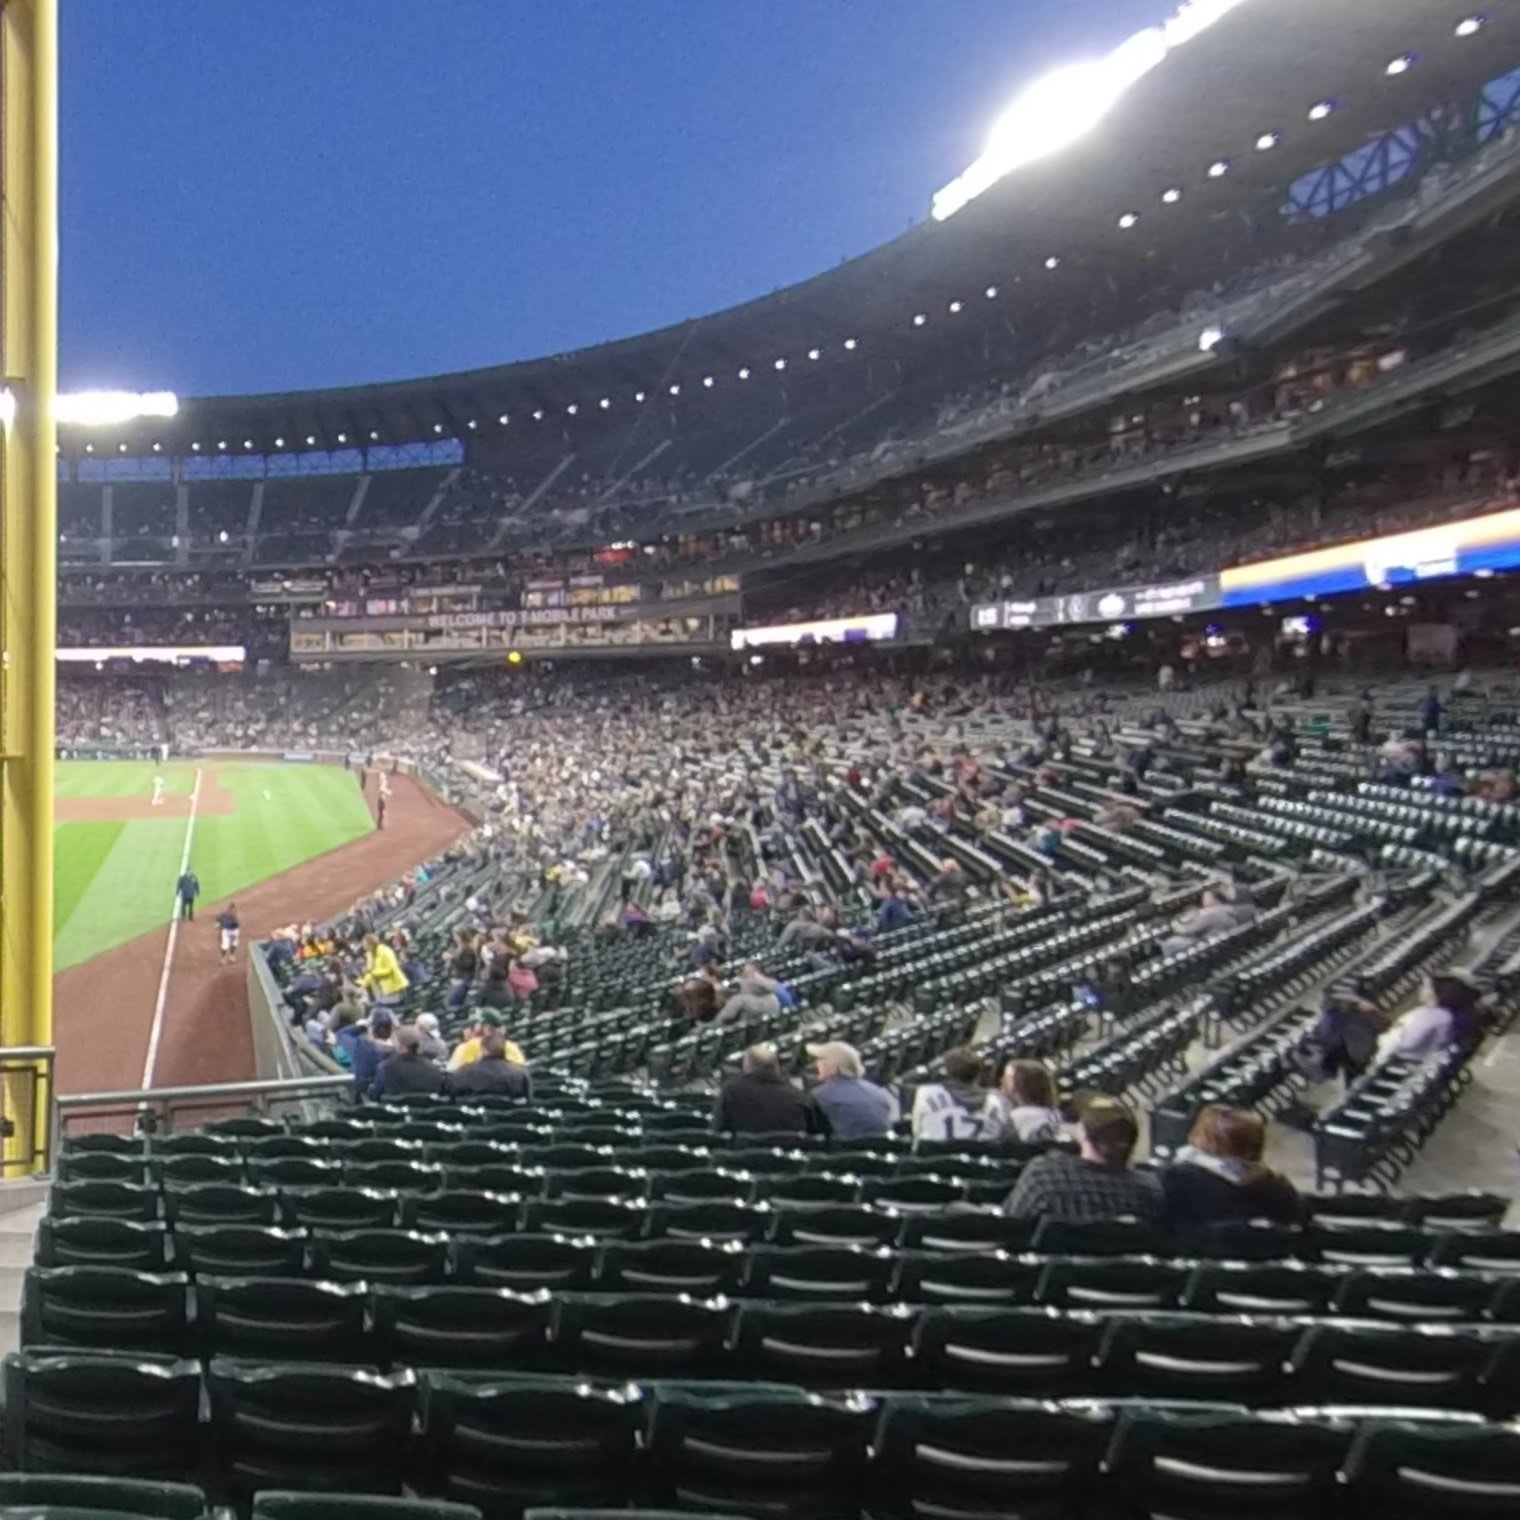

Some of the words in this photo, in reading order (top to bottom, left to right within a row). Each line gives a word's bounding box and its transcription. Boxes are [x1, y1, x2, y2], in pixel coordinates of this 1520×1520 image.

[429, 611, 494, 628] WELCOME
[499, 609, 515, 625] TO
[582, 605, 617, 620] PARK
